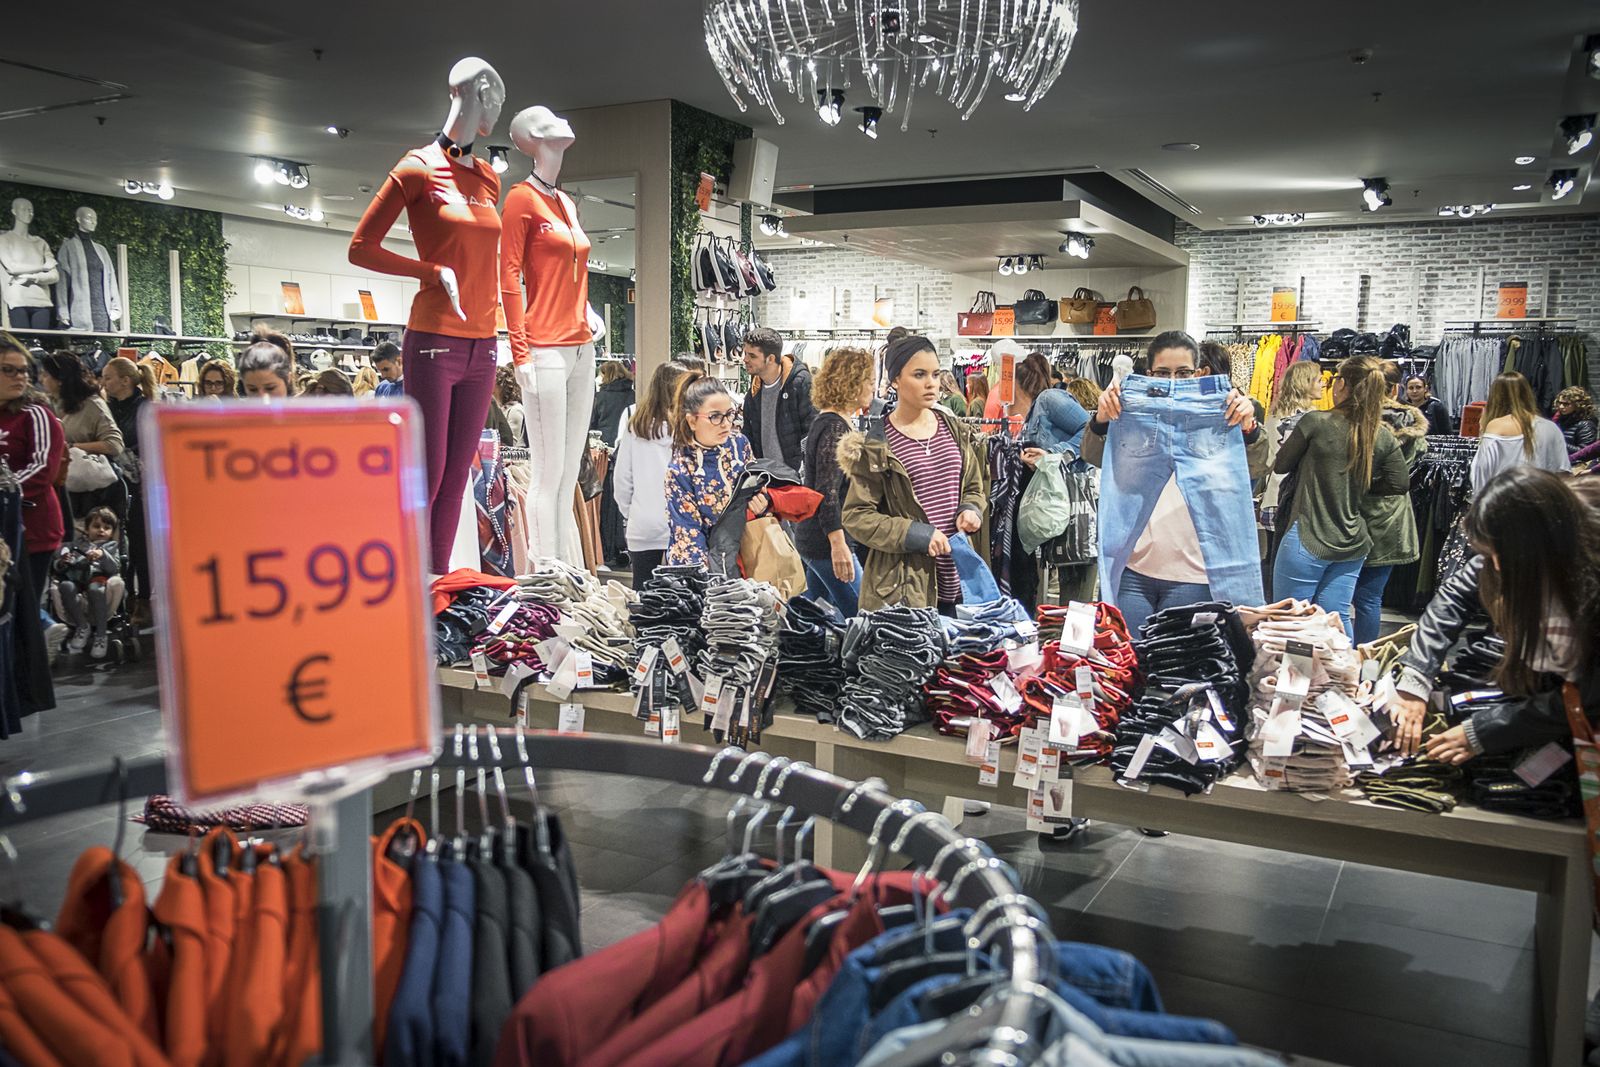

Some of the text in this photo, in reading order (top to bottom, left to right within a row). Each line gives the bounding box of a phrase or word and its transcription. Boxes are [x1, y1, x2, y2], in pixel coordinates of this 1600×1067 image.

[1280, 312, 1288, 320] €
[184, 438, 393, 481] Todo a
[194, 539, 397, 626] 15,99
[284, 652, 335, 724] €
